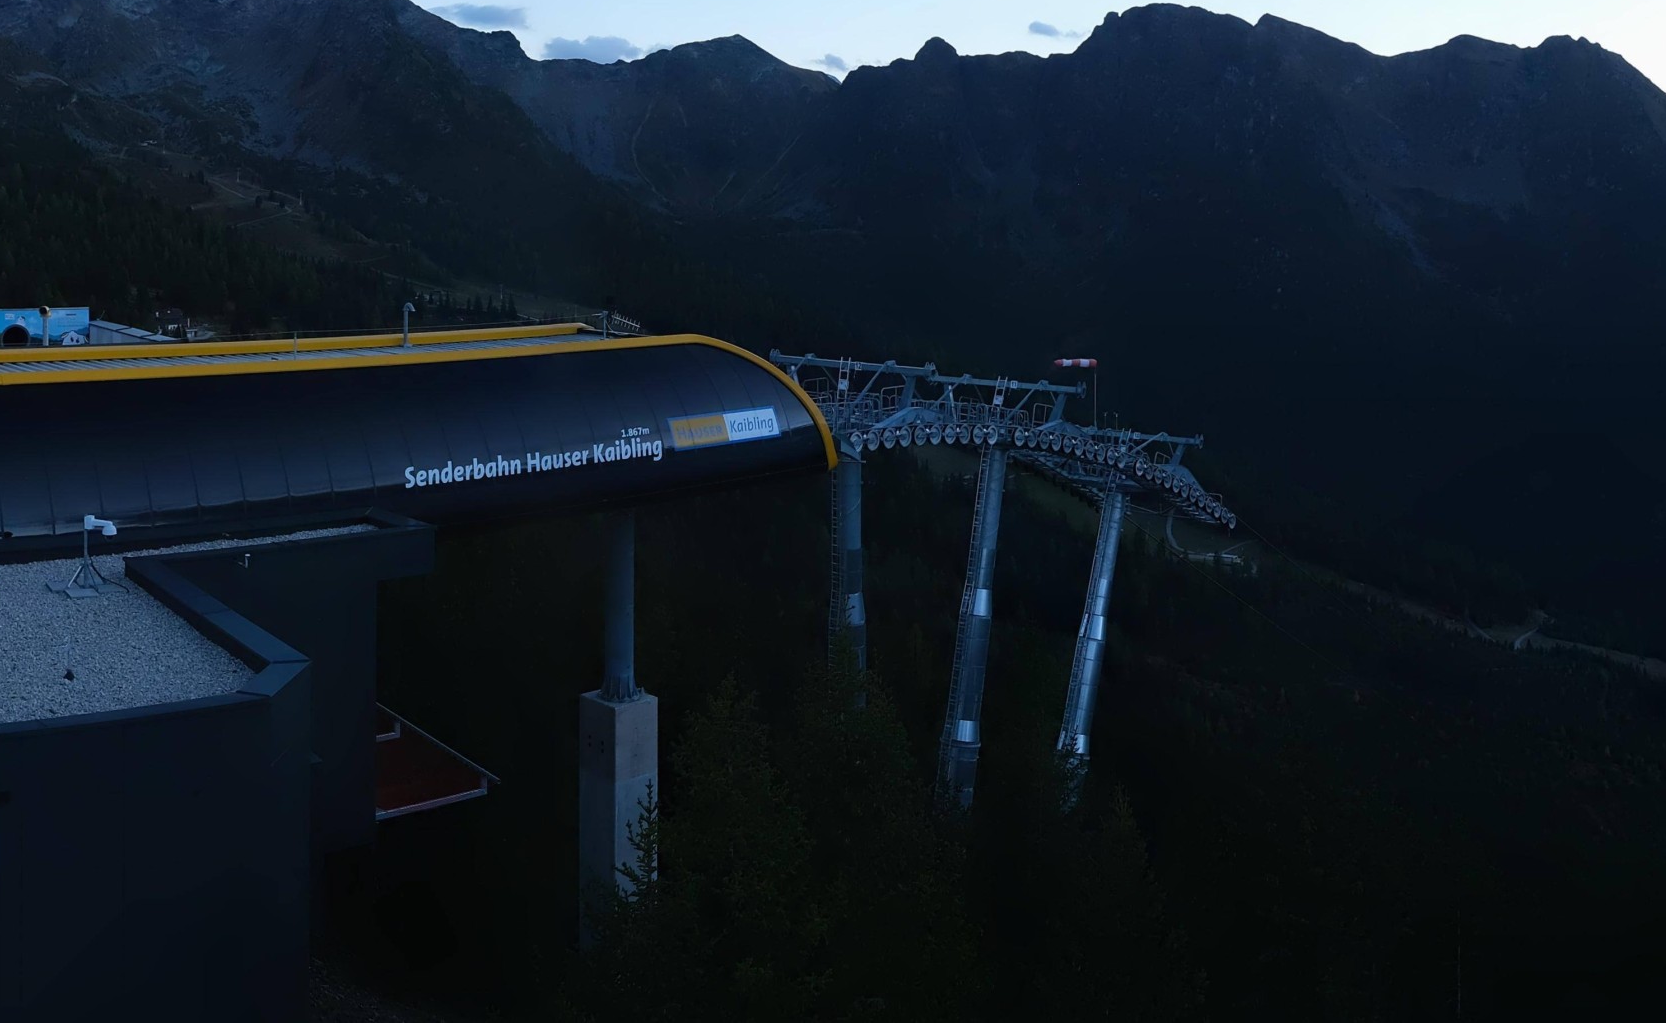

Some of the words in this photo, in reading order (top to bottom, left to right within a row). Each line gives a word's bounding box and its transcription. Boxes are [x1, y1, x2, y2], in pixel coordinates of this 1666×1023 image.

[730, 417, 774, 435] Kaibling
[404, 455, 522, 489] Senderbahn
[526, 449, 589, 474] Hauser
[593, 437, 663, 463] Kaibling
